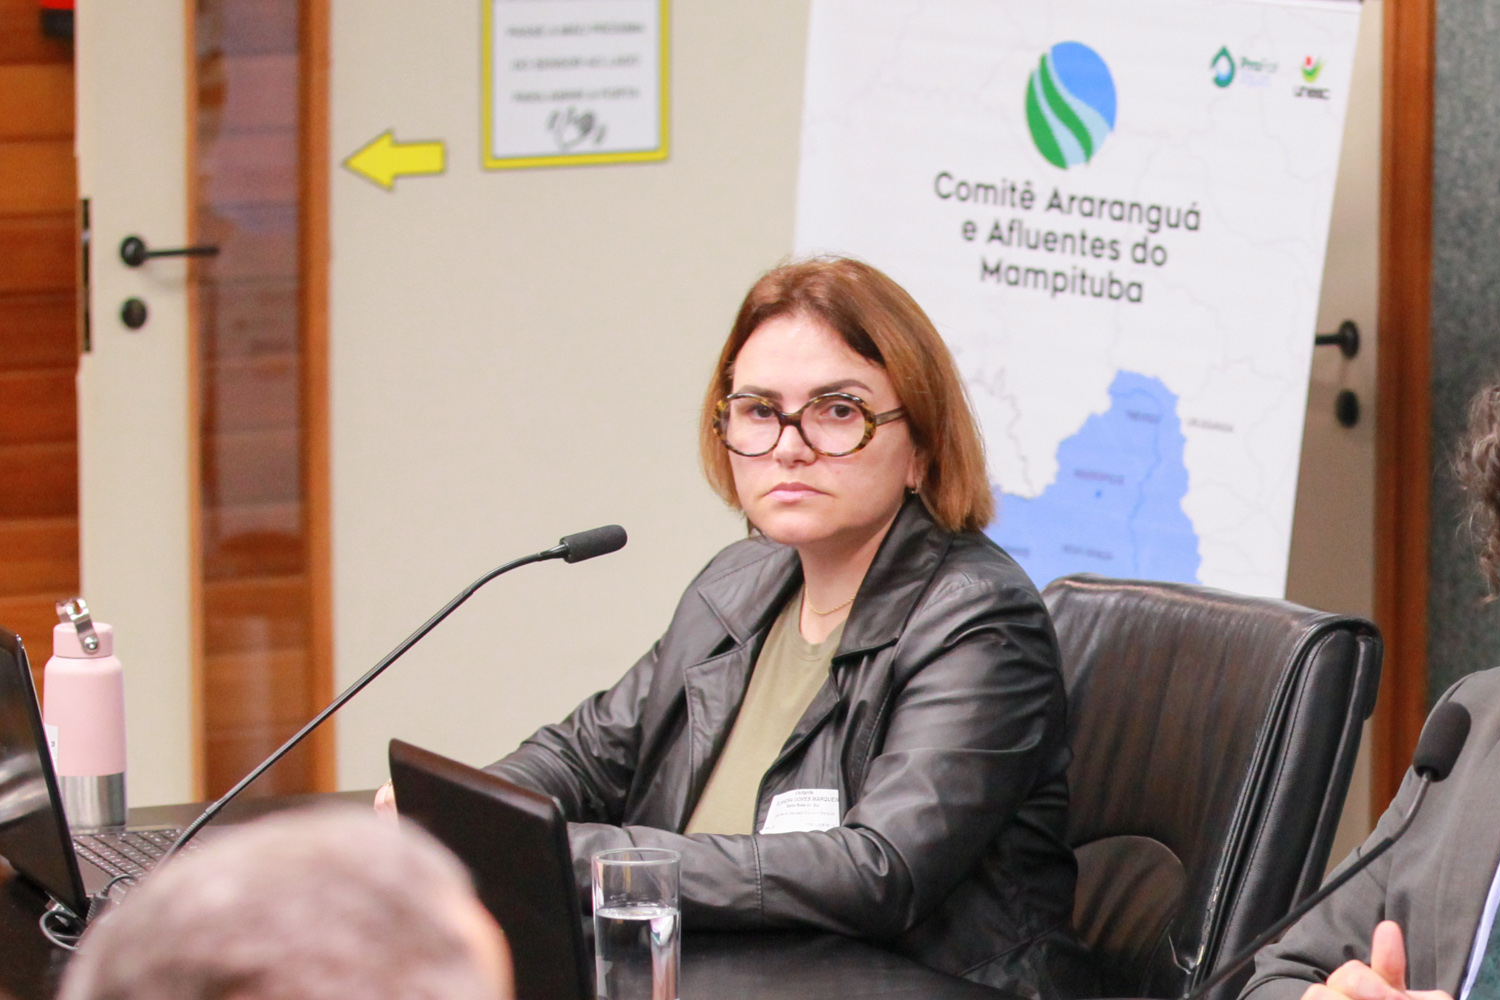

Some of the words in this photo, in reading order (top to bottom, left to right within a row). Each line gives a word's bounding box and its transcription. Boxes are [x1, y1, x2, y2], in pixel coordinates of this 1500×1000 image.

[934, 171, 1035, 210] Comitê
[1046, 188, 1200, 233] Araranguá
[962, 221, 977, 242] e
[987, 219, 1120, 261] Afluentes
[1131, 237, 1167, 267] do
[980, 257, 1143, 303] Mampituba
